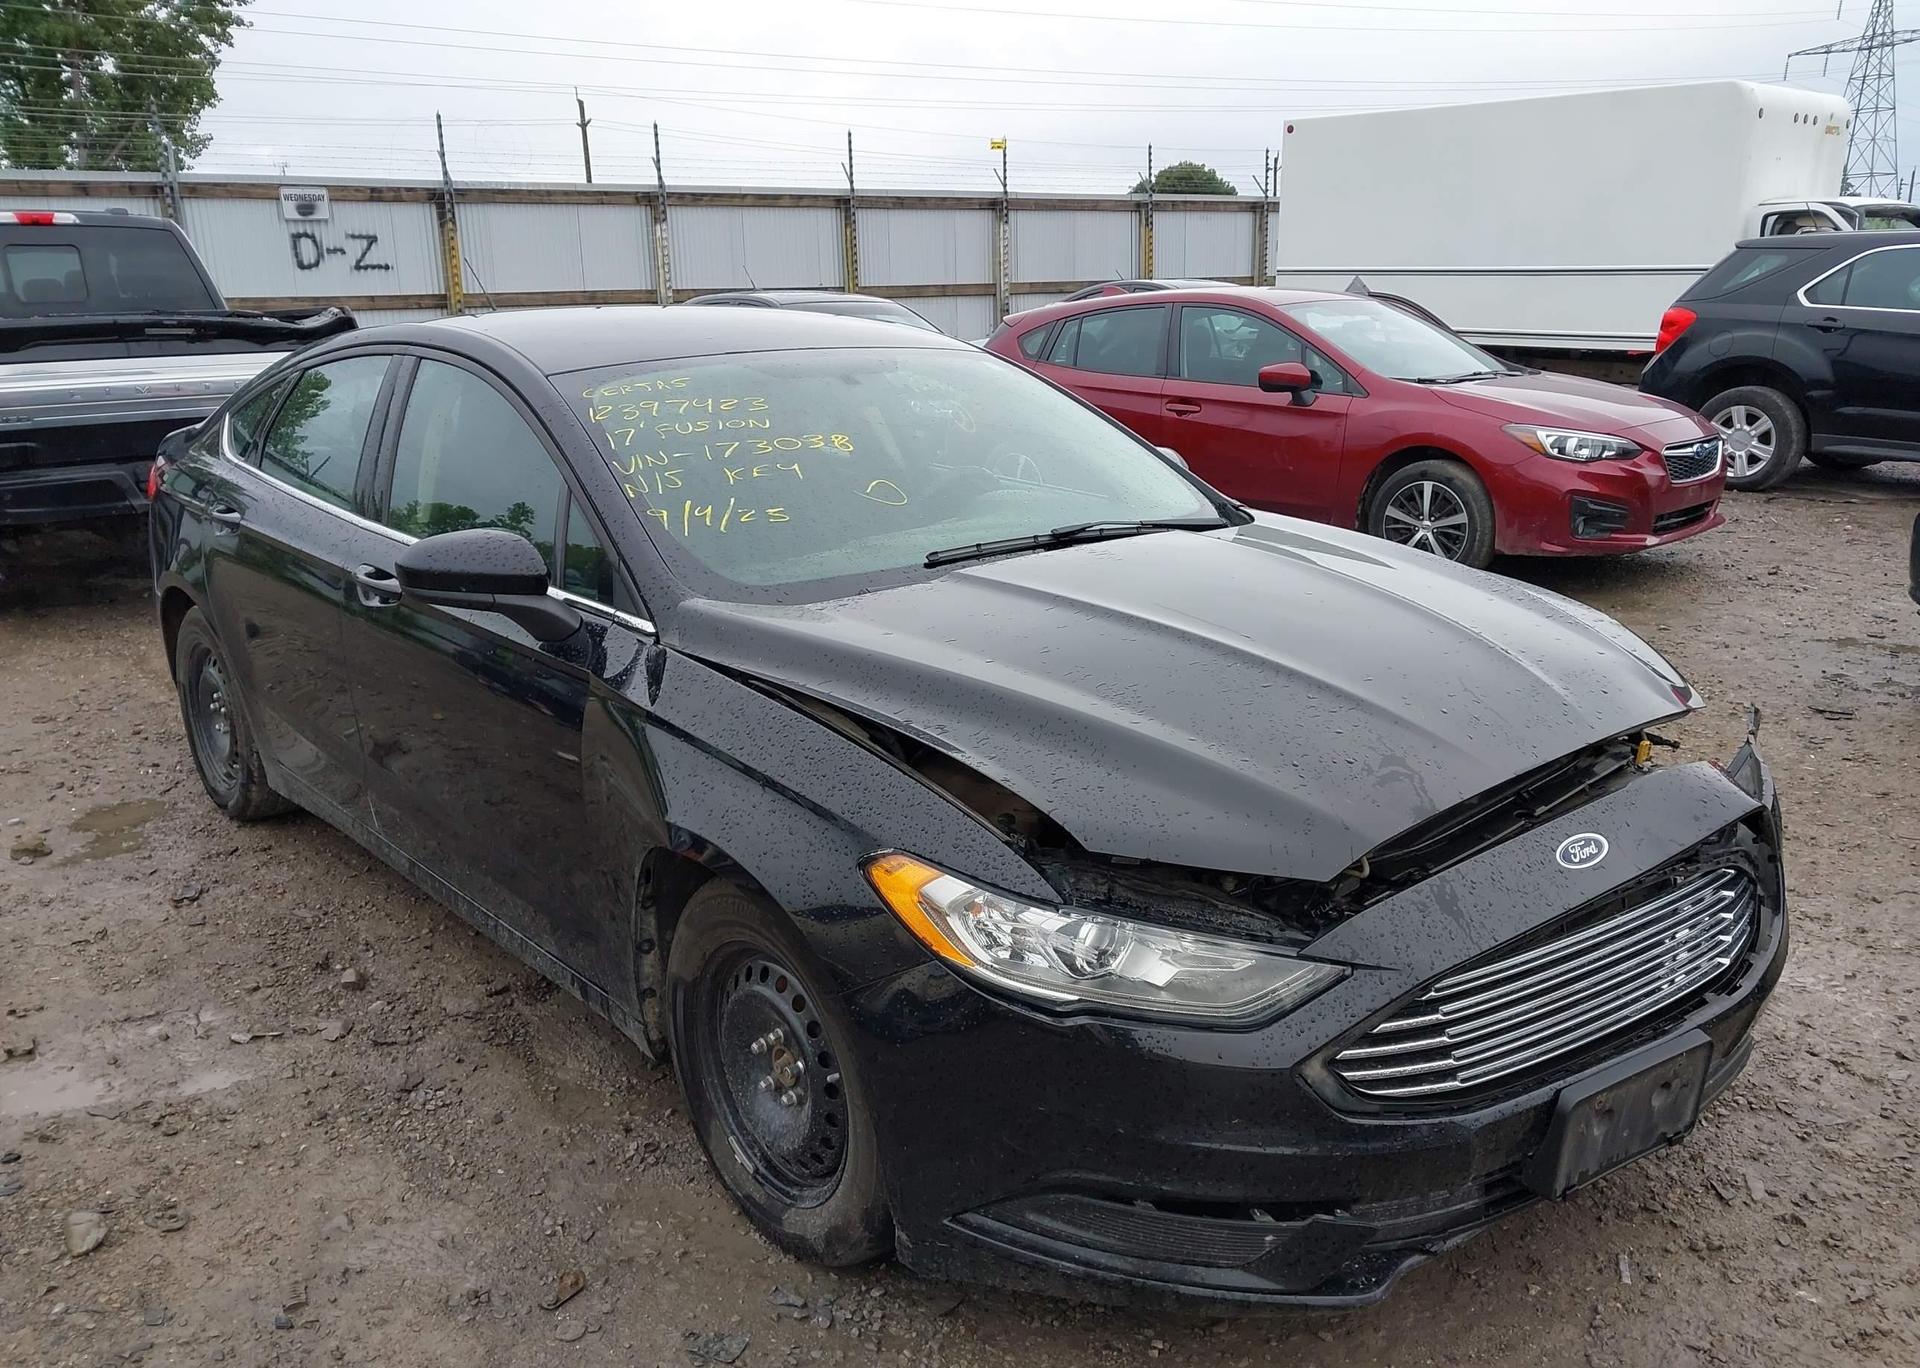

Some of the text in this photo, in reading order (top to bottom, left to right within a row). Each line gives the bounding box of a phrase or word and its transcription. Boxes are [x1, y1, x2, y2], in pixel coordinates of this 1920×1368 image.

[282, 193, 326, 203] WEDNESDAY
[654, 418, 770, 440] FUSION
[723, 462, 804, 486] KEY
[1568, 840, 1599, 863] Ford
